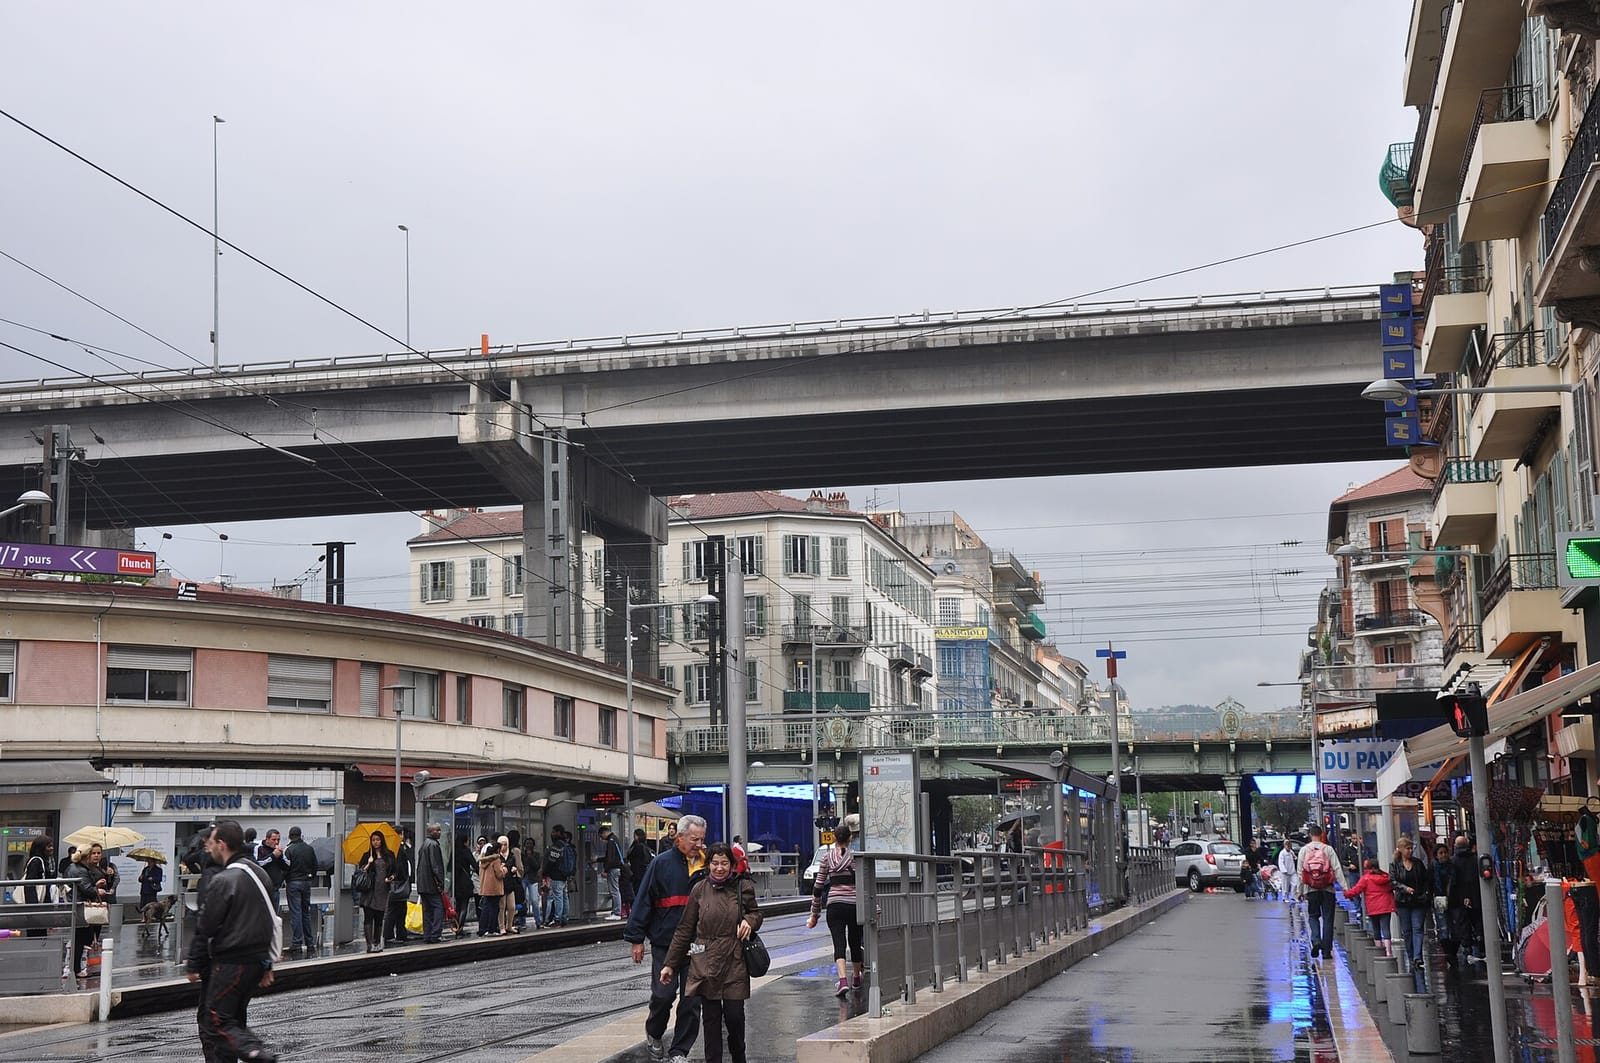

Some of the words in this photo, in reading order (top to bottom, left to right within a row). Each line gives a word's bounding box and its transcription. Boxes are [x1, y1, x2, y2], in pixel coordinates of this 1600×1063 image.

[23, 555, 52, 566] jours
[120, 557, 151, 570] flunch
[1324, 751, 1350, 770] DU
[1356, 751, 1395, 770] PAN
[1323, 783, 1377, 793] BELL
[162, 794, 242, 809] AUDITION
[249, 794, 311, 809] CONSEIL
[823, 834, 832, 842] 15
